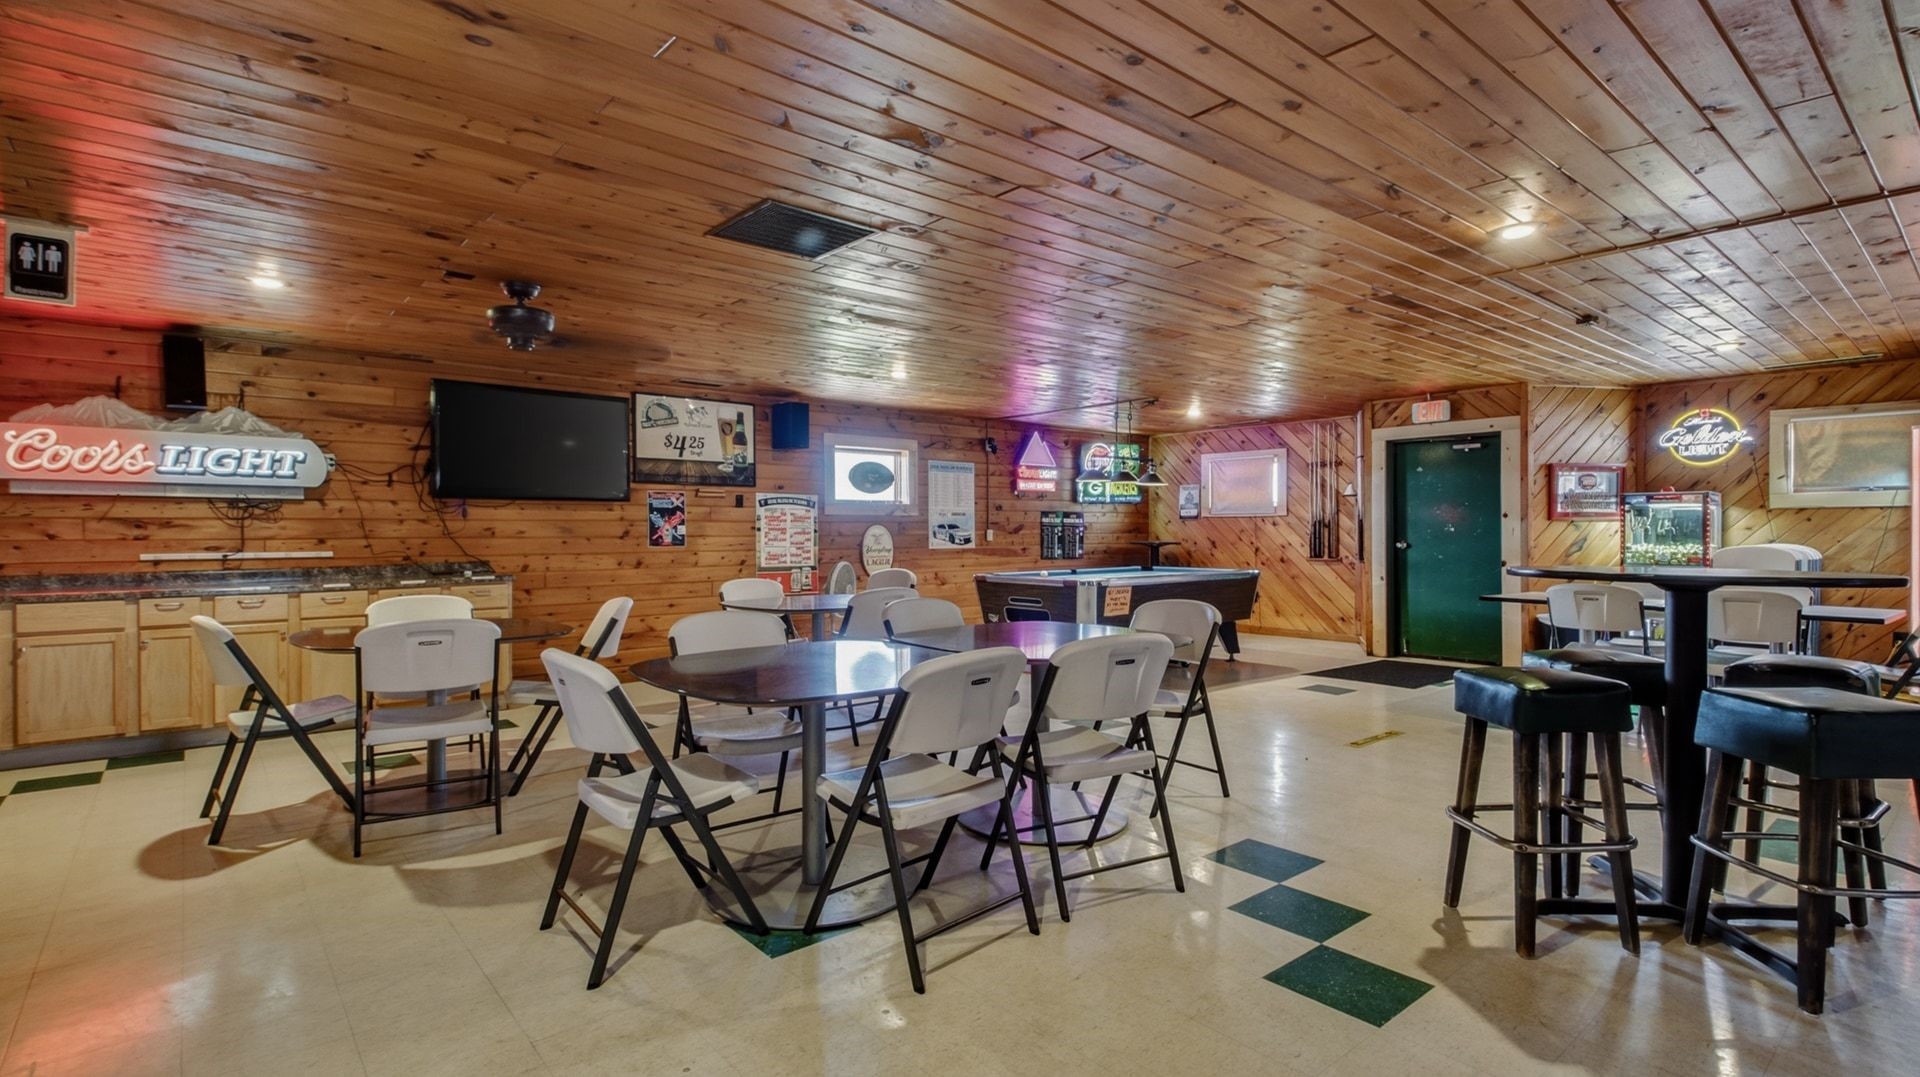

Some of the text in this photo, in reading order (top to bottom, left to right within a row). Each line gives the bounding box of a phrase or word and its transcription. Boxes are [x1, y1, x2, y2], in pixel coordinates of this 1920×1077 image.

[4, 428, 305, 479] Coors LIGHT
[1660, 424, 1753, 447] Golden
